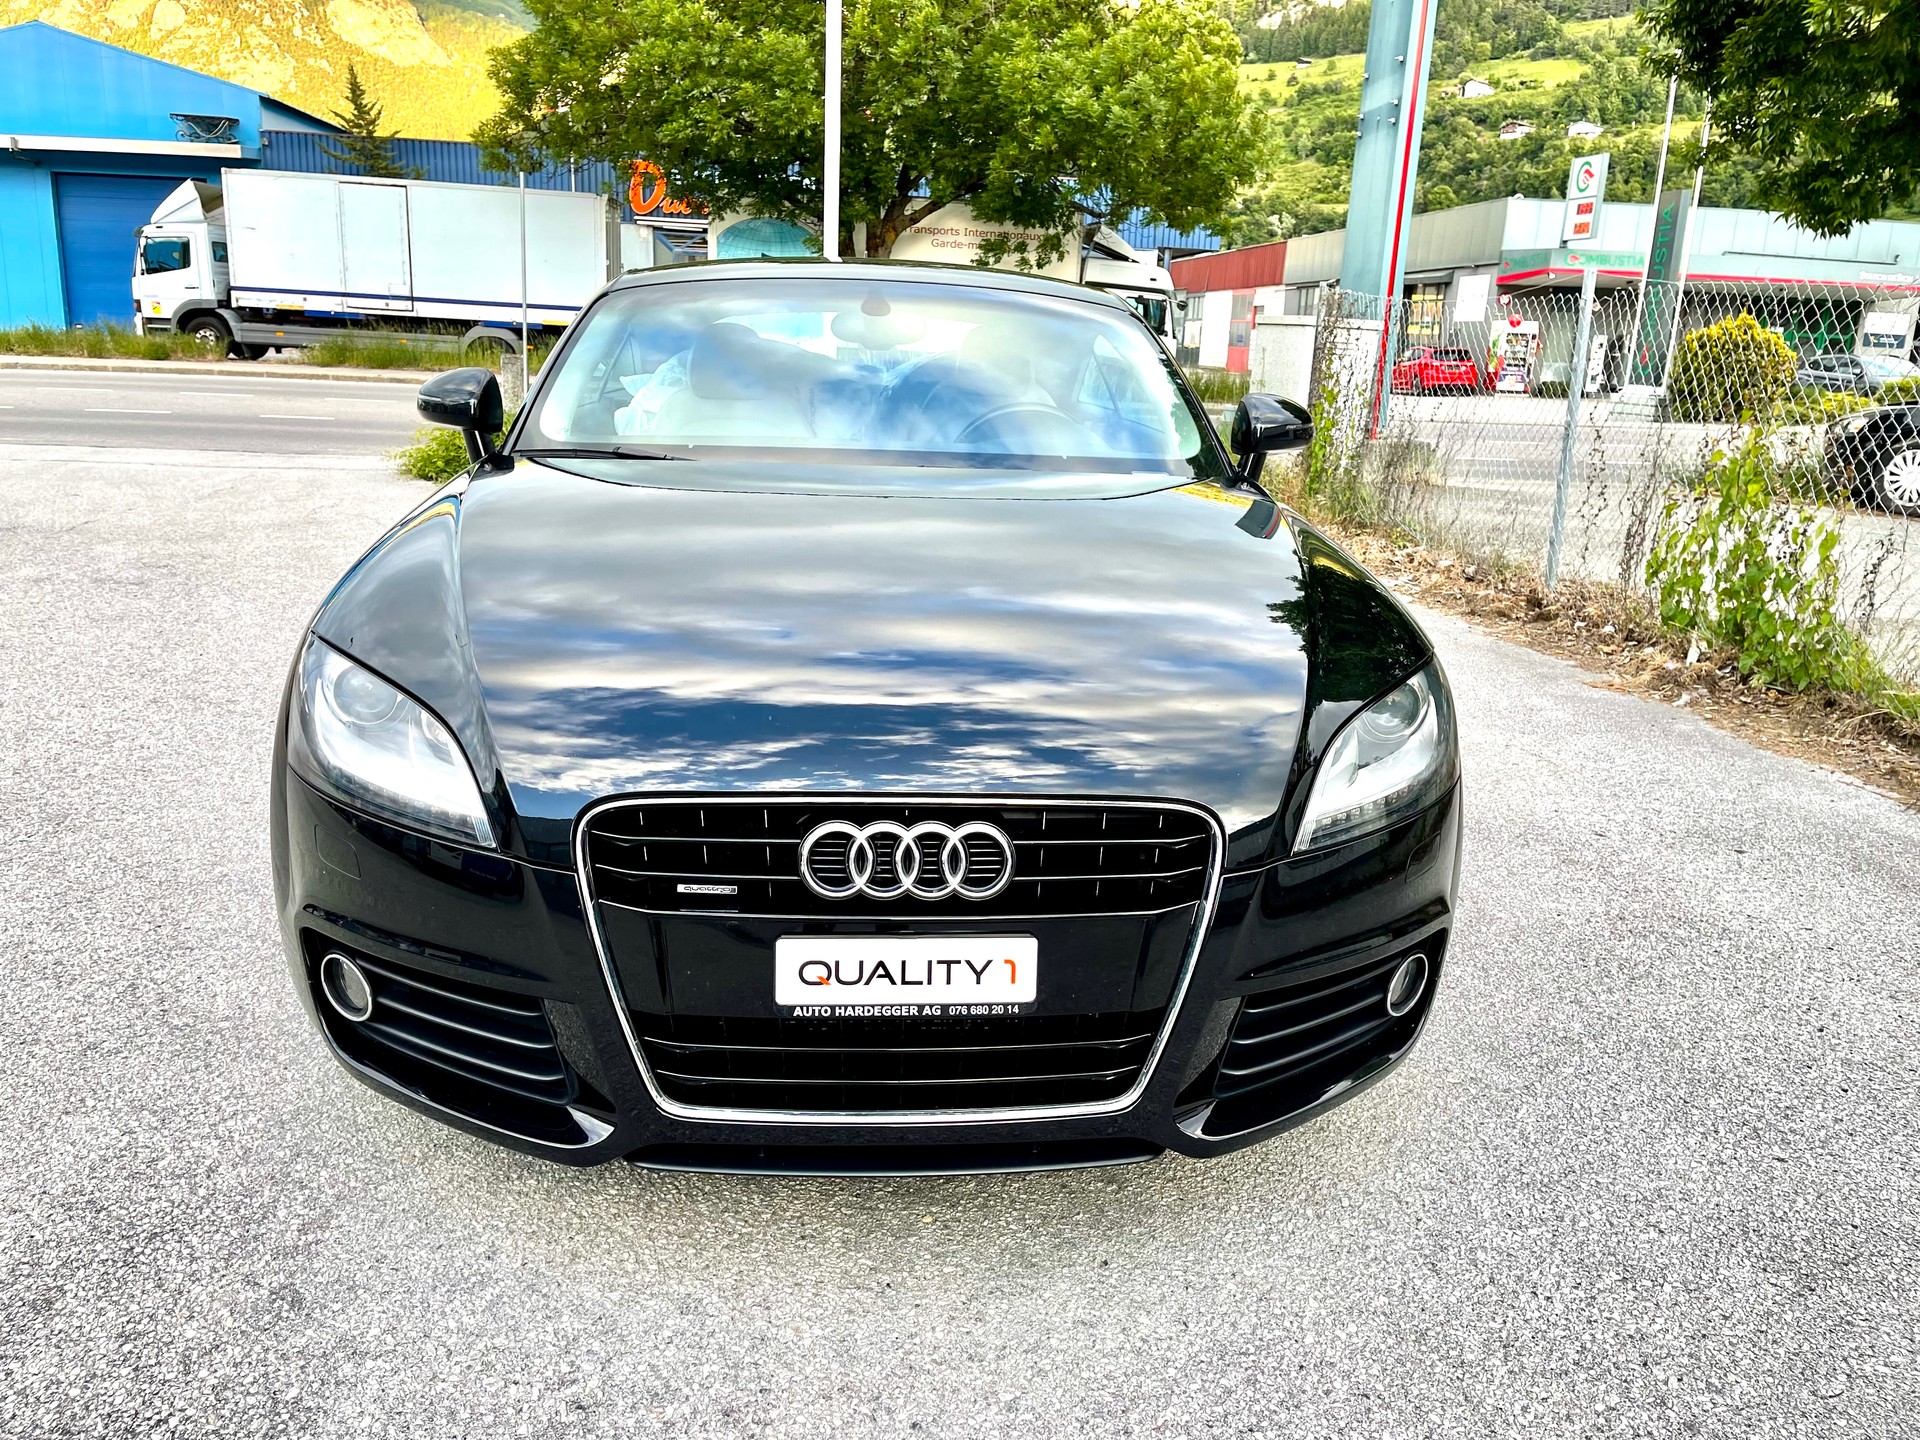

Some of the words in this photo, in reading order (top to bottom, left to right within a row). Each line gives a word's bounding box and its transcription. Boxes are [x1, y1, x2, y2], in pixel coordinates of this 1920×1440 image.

[963, 227, 1042, 241] Internationaux
[930, 237, 979, 250] Garde-m
[682, 885, 733, 893] quattro
[798, 959, 994, 986] QUALITY
[1003, 959, 1017, 985] 1
[792, 1005, 832, 1017] AUTO
[834, 1005, 919, 1017] HARDEGGER
[921, 1005, 942, 1017] AG
[948, 1005, 969, 1016] 076
[970, 1005, 989, 1016] 680
[991, 1005, 1004, 1016] 20
[1007, 1004, 1020, 1015] 14
